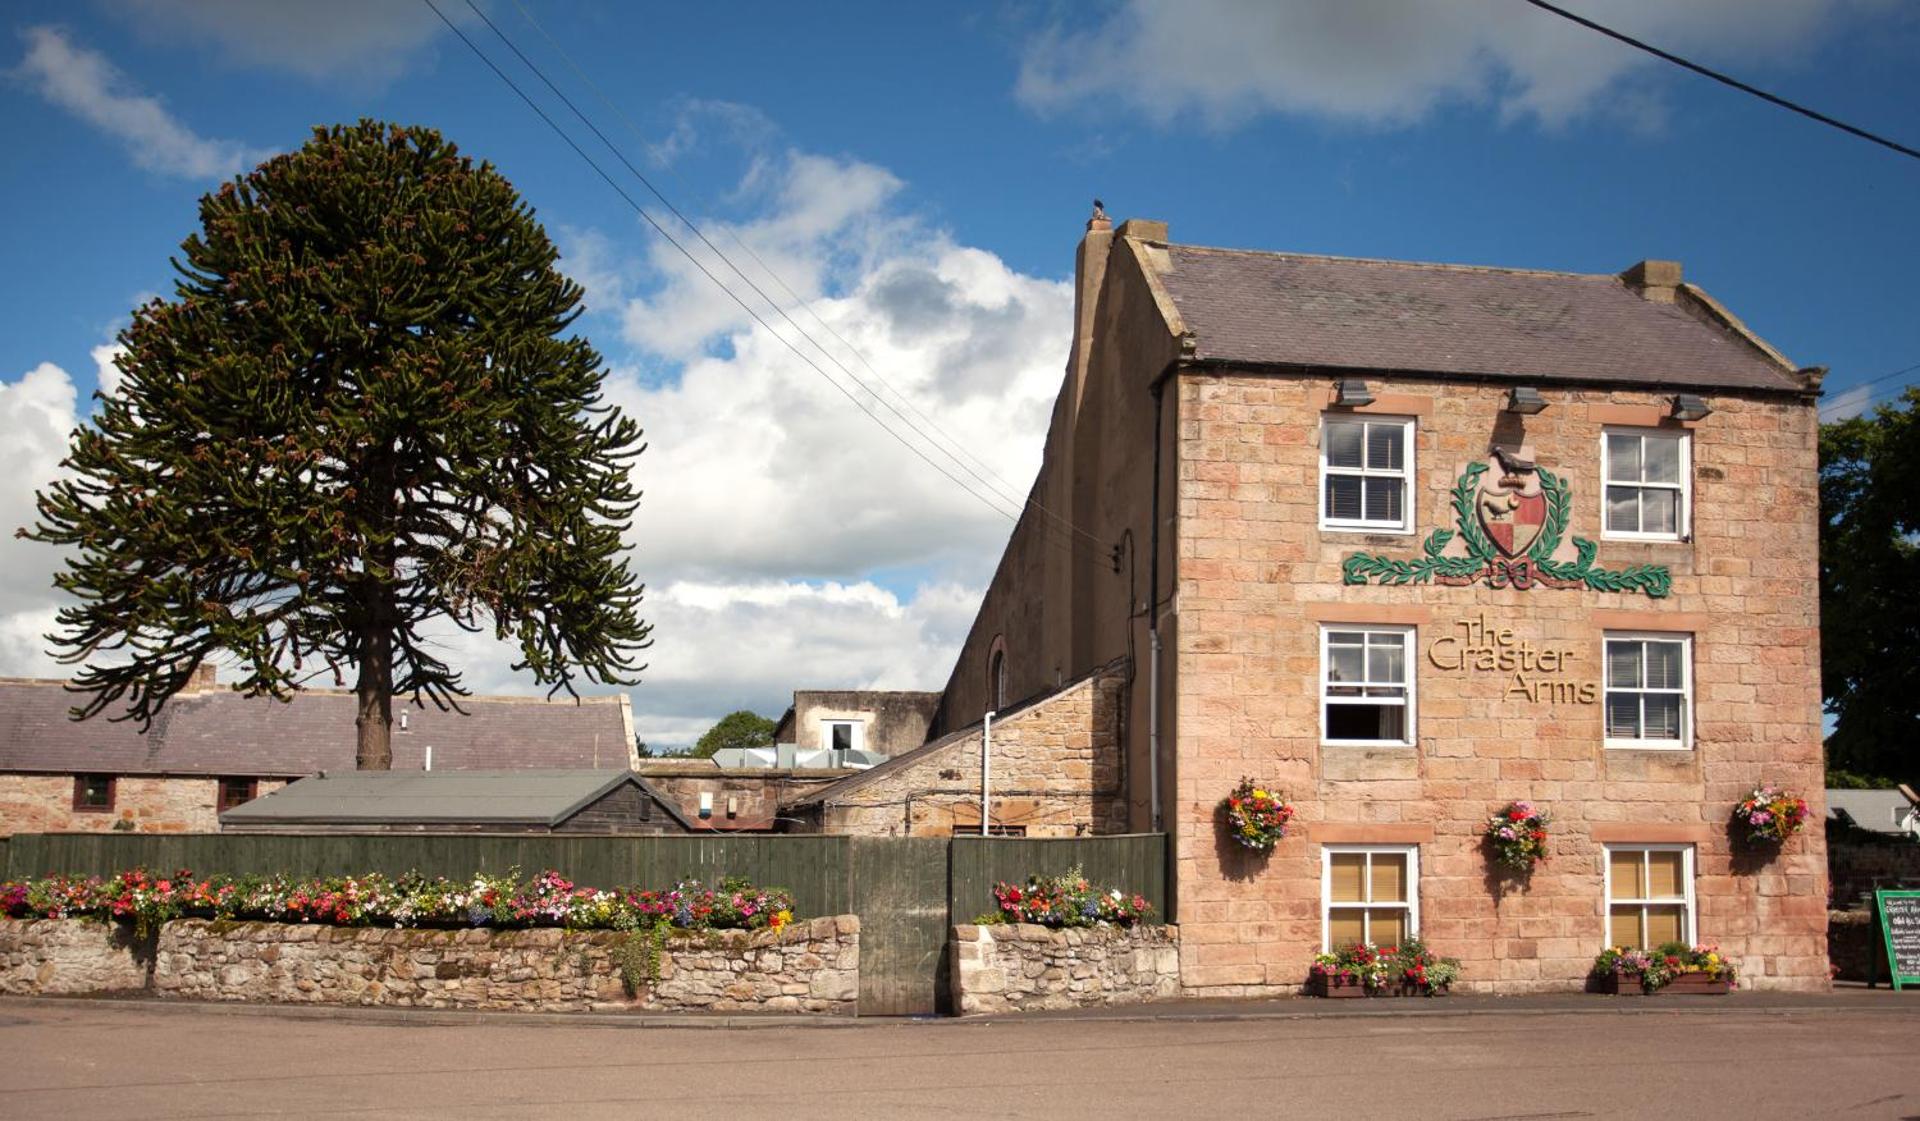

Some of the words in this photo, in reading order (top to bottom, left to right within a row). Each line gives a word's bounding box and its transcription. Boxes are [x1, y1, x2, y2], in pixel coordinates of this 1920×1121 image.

[1457, 613, 1514, 647] The
[1428, 637, 1574, 673] Craster
[1502, 671, 1596, 705] Arms
